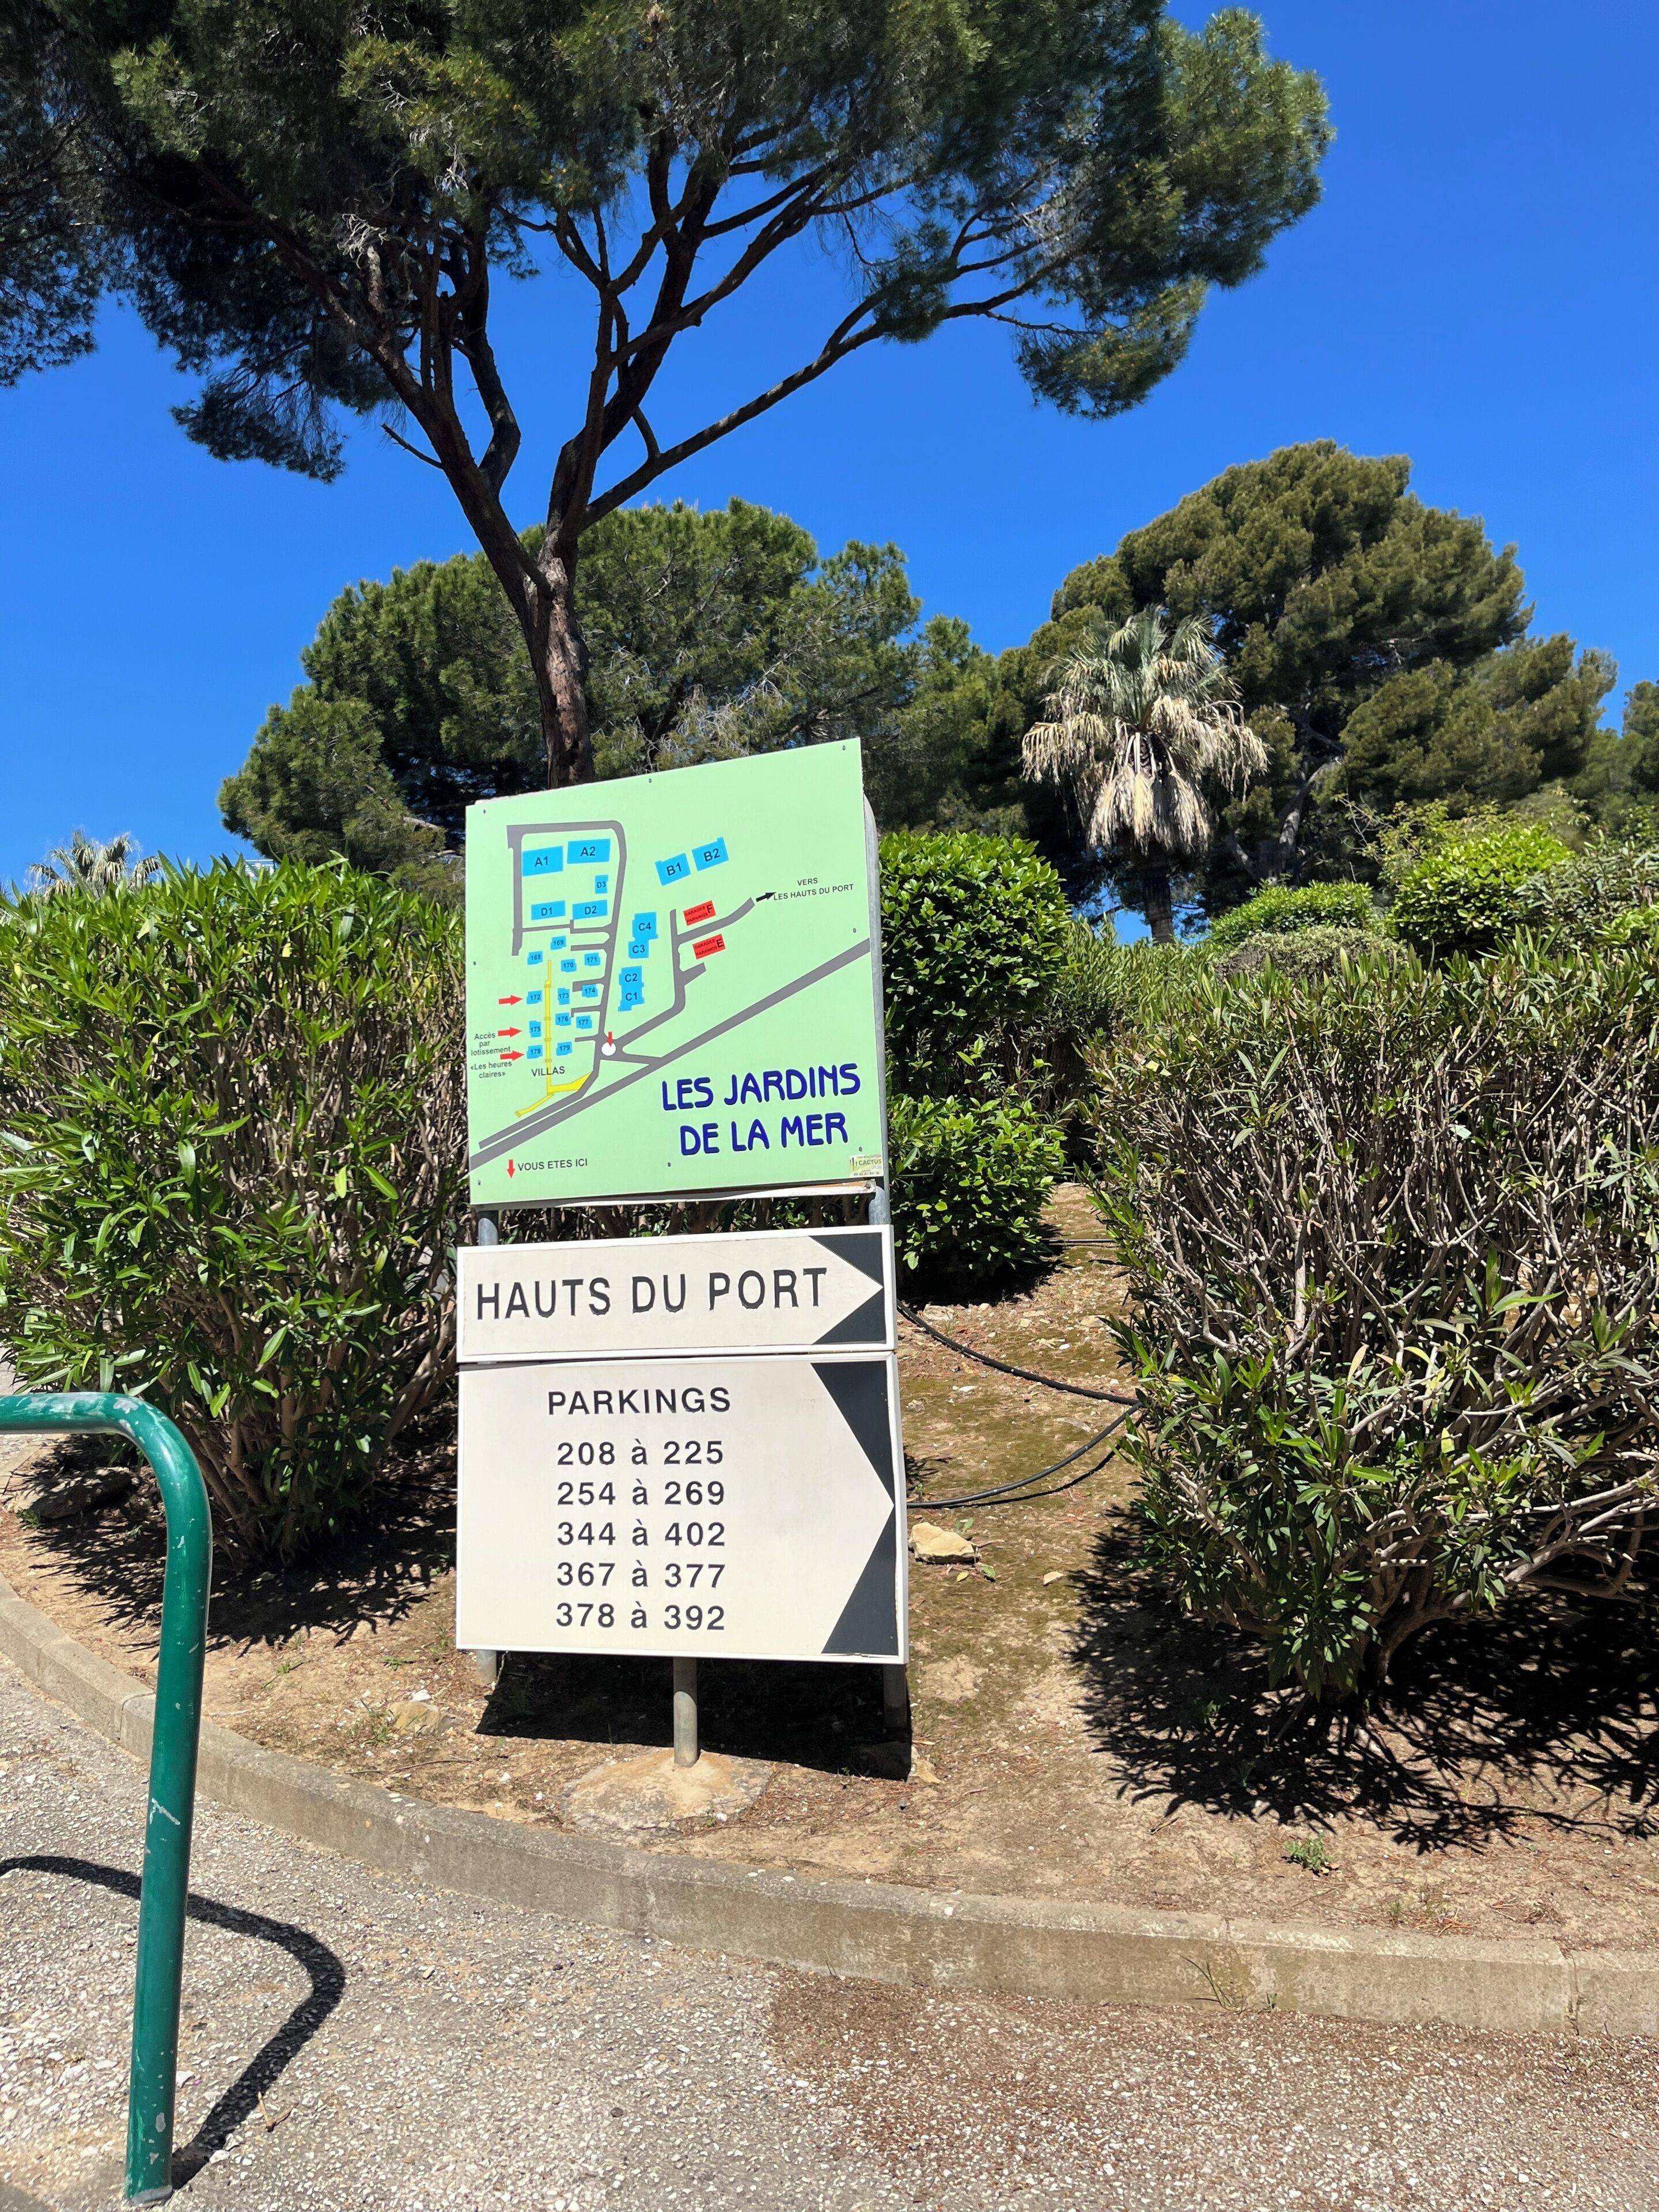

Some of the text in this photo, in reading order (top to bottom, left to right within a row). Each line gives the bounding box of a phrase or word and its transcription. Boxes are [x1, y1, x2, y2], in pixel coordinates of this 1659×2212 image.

[580, 846, 596, 857] A2
[703, 849, 720, 862] B2
[535, 857, 548, 867] A1
[666, 863, 681, 876] B1
[797, 878, 818, 886] VERS
[790, 889, 817, 898] HAUTS
[832, 884, 854, 892] PORT
[541, 907, 552, 916] D1
[585, 906, 597, 915] D2
[707, 904, 713, 913] F
[638, 922, 652, 931] C4
[717, 938, 724, 948] E
[632, 945, 645, 953] C3
[625, 974, 637, 982] C2
[626, 993, 637, 1001] C1
[474, 1032, 495, 1040] Accès
[471, 1046, 511, 1056] lotissement
[488, 1061, 512, 1070] heures
[531, 1066, 565, 1077] VILLAS
[662, 1063, 861, 1111] LES JARDINS
[680, 1112, 848, 1156] DE LA MER
[517, 1158, 588, 1171] VOUS ETES ICI
[477, 1267, 827, 1320] HAUTS DU PORT
[548, 1387, 732, 1415] PARKINGS
[557, 1439, 724, 1465] 208 à 225
[557, 1479, 725, 1505] 254 à 269
[557, 1519, 725, 1547] 344 à 402
[556, 1560, 725, 1588] 367 à 377
[556, 1601, 725, 1630] 378 à 392
